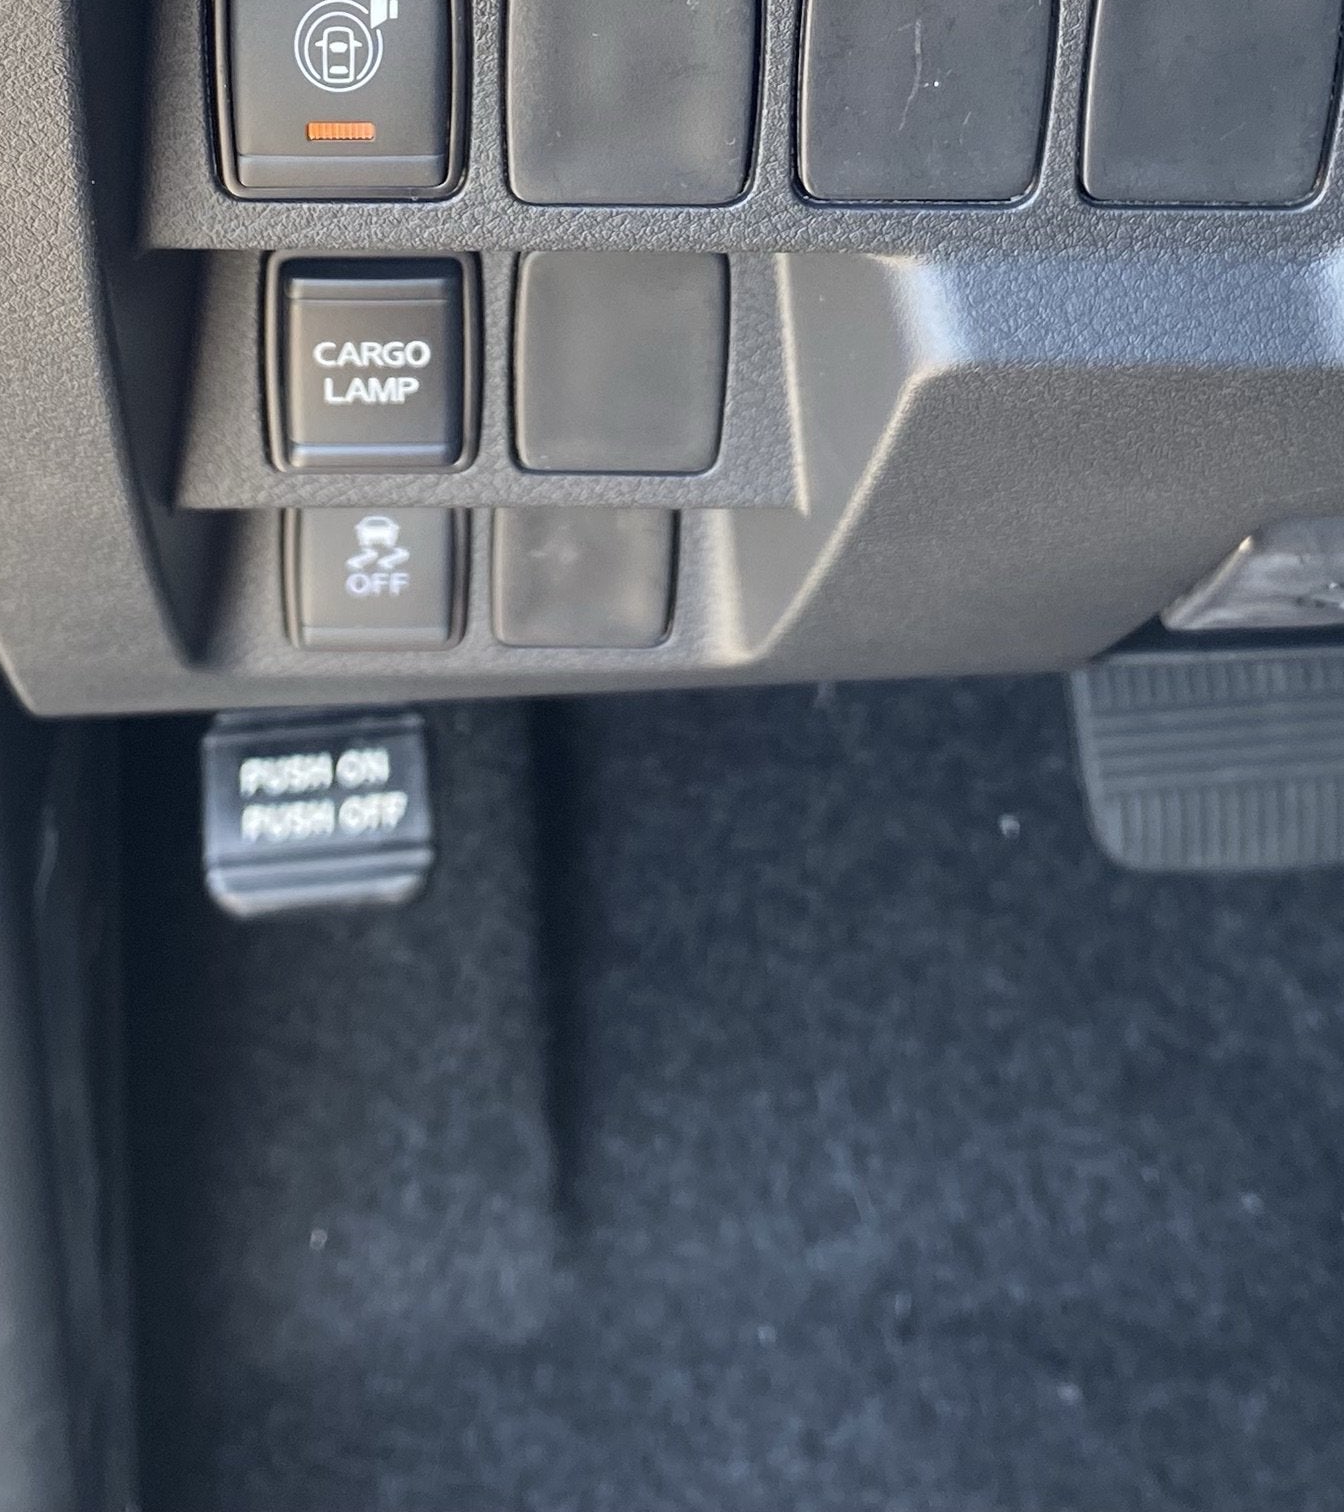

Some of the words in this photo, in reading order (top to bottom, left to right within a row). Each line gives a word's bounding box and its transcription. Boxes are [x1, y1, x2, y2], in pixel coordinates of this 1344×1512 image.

[313, 340, 432, 368] CARGO
[323, 376, 420, 405] LAMP
[346, 572, 410, 597] OFF
